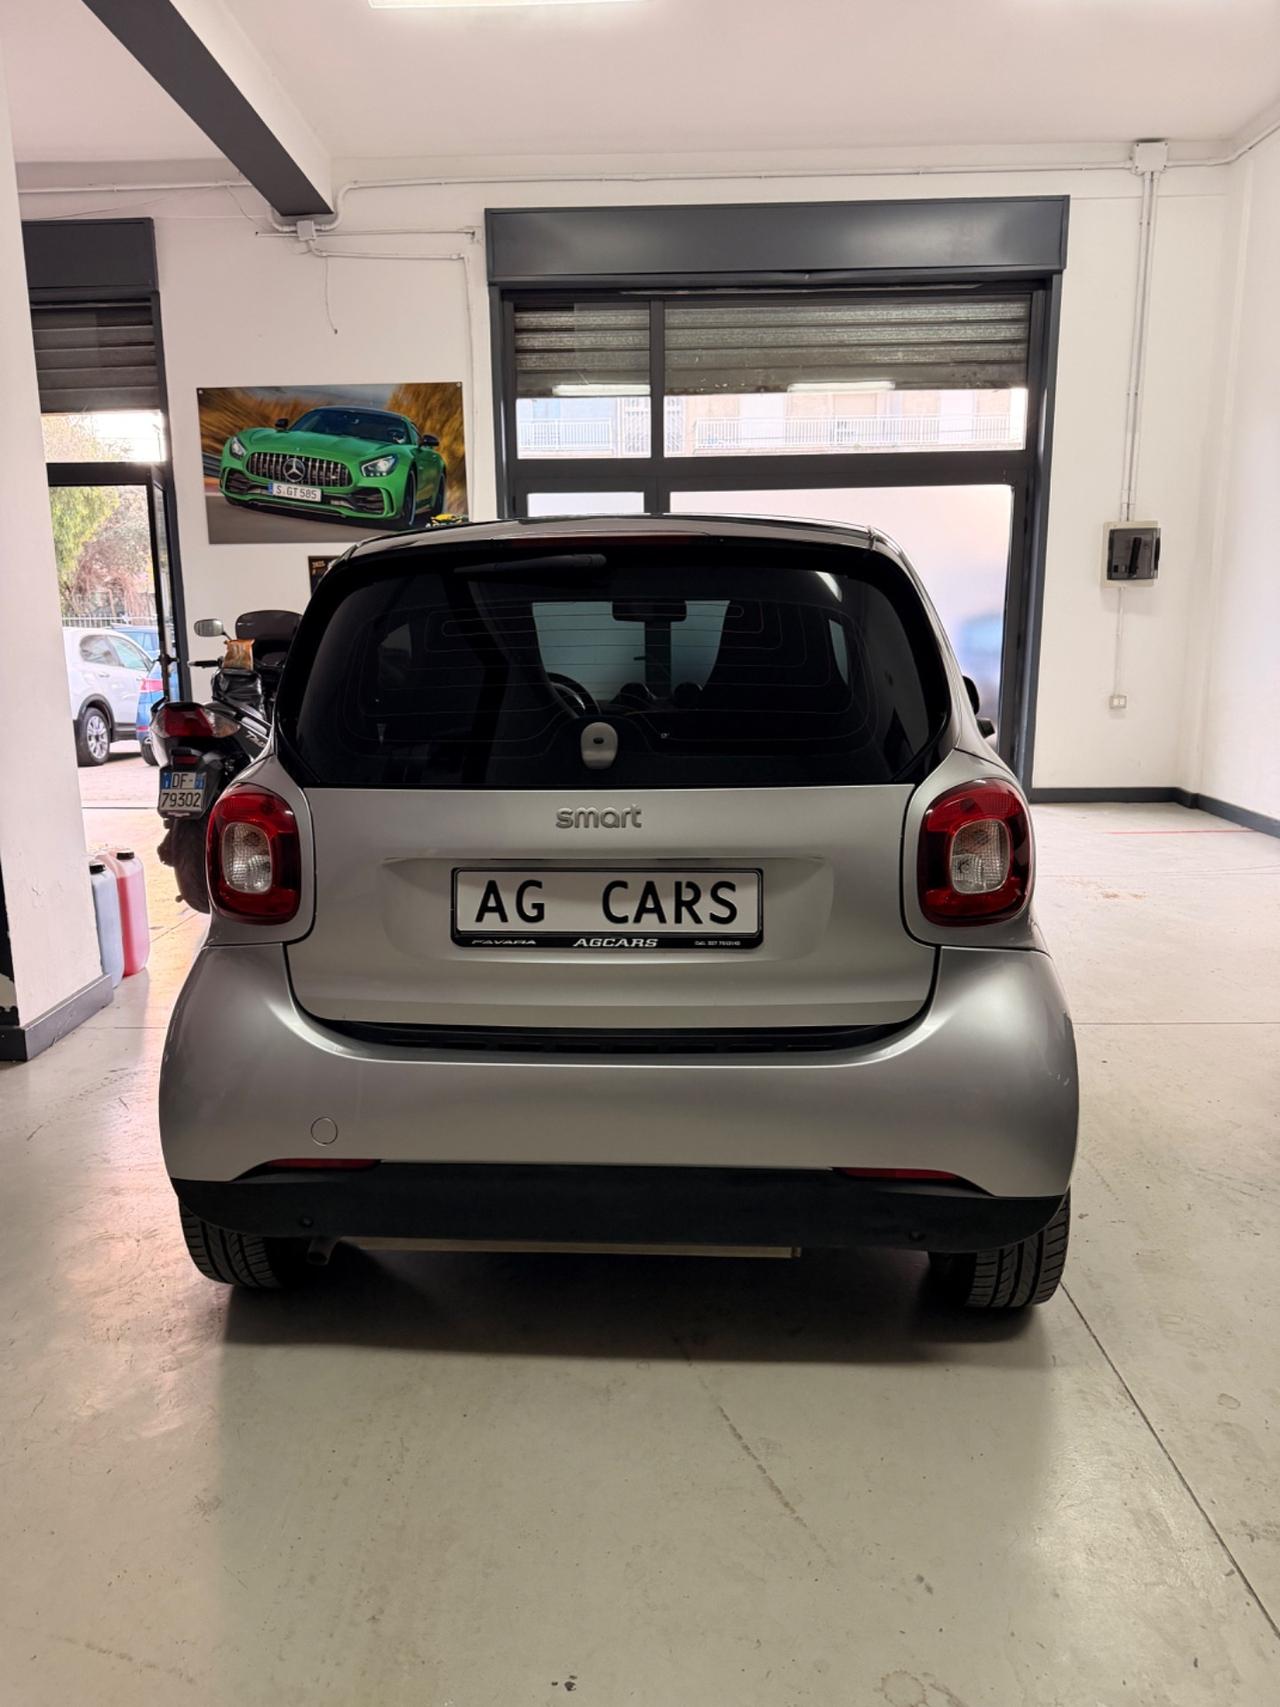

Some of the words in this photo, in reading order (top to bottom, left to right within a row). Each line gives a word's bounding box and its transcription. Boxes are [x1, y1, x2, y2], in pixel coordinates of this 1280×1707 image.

[286, 486, 298, 496] GT
[300, 489, 317, 499] 585
[161, 793, 201, 807] 79302
[555, 804, 642, 829] smart
[475, 880, 545, 923] AG
[602, 881, 737, 924] CARS
[573, 938, 659, 948] AGCARS
